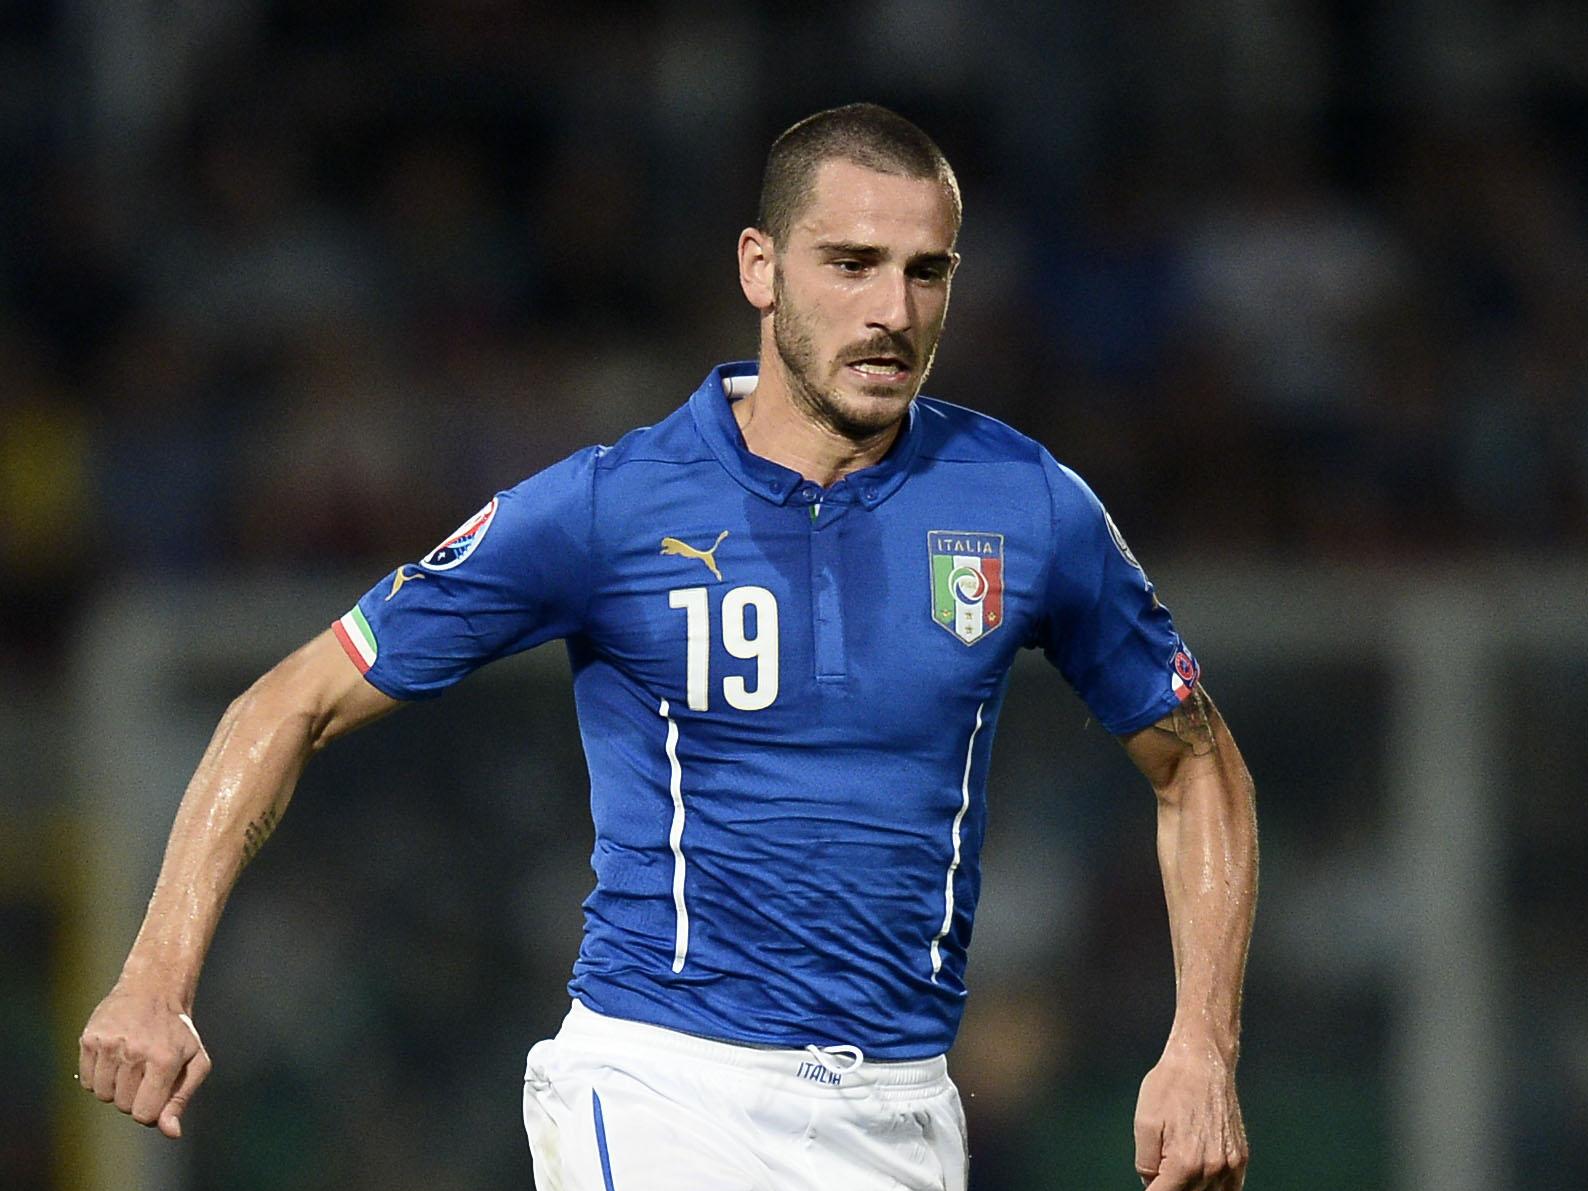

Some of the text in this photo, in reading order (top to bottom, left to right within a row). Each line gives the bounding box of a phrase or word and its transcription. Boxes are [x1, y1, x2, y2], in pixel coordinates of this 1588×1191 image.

[937, 538, 992, 553] ITALIA
[668, 585, 779, 712] 19
[796, 1061, 842, 1085] ITALIA
